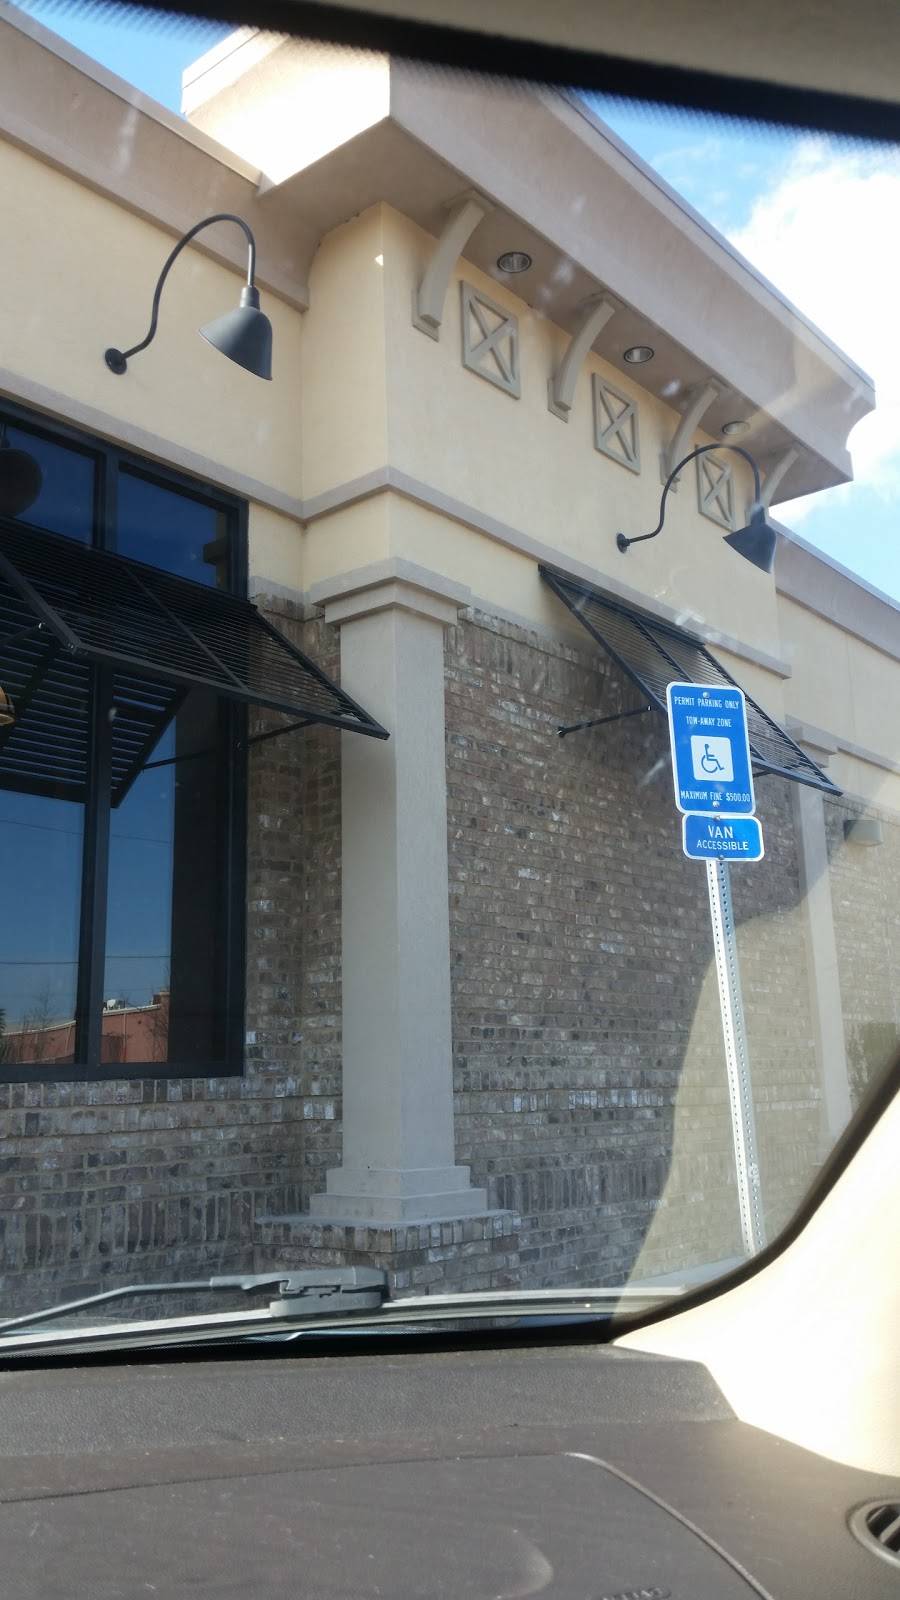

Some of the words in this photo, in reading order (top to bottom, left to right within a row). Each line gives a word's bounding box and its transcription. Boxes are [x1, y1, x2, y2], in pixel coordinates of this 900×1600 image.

[674, 696, 695, 706] PERMIT
[697, 698, 722, 709] PARKING
[724, 700, 739, 709] ONLY
[686, 715, 715, 726] TOW-AWAY
[717, 718, 732, 727] ZONE
[680, 790, 708, 800] MAXIMUM
[710, 791, 723, 801] FINE
[726, 792, 751, 802] $500.00
[708, 825, 733, 839] VAN
[696, 840, 749, 851] ACCESSIBLE
